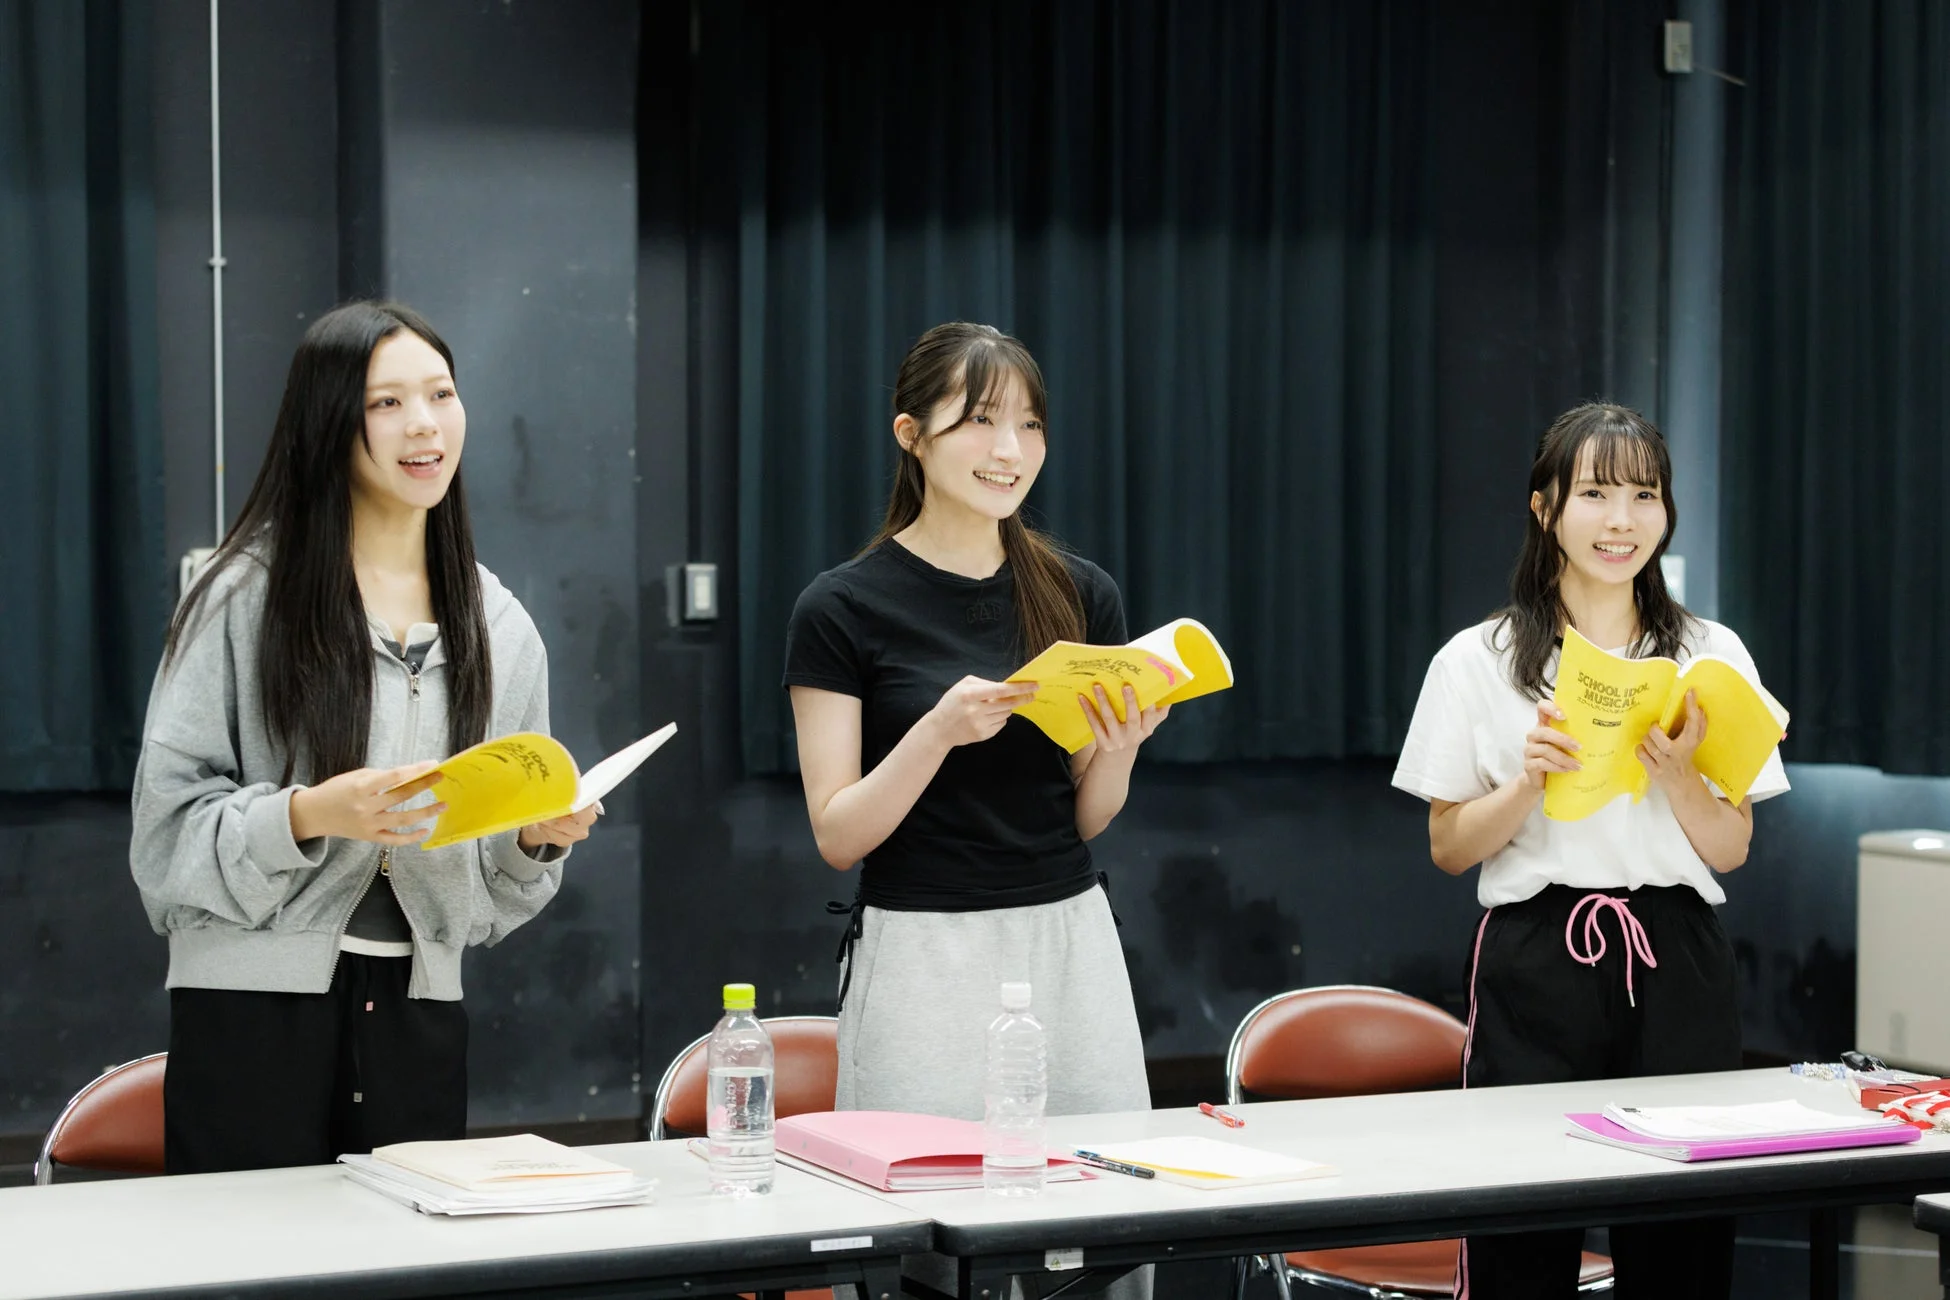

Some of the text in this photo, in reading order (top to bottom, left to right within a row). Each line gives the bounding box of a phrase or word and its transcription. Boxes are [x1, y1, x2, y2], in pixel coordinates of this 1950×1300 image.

[966, 602, 1002, 624] GAP
[1577, 671, 1650, 698] SCHOOL IDOL
[1583, 688, 1637, 708] MUSICAL
